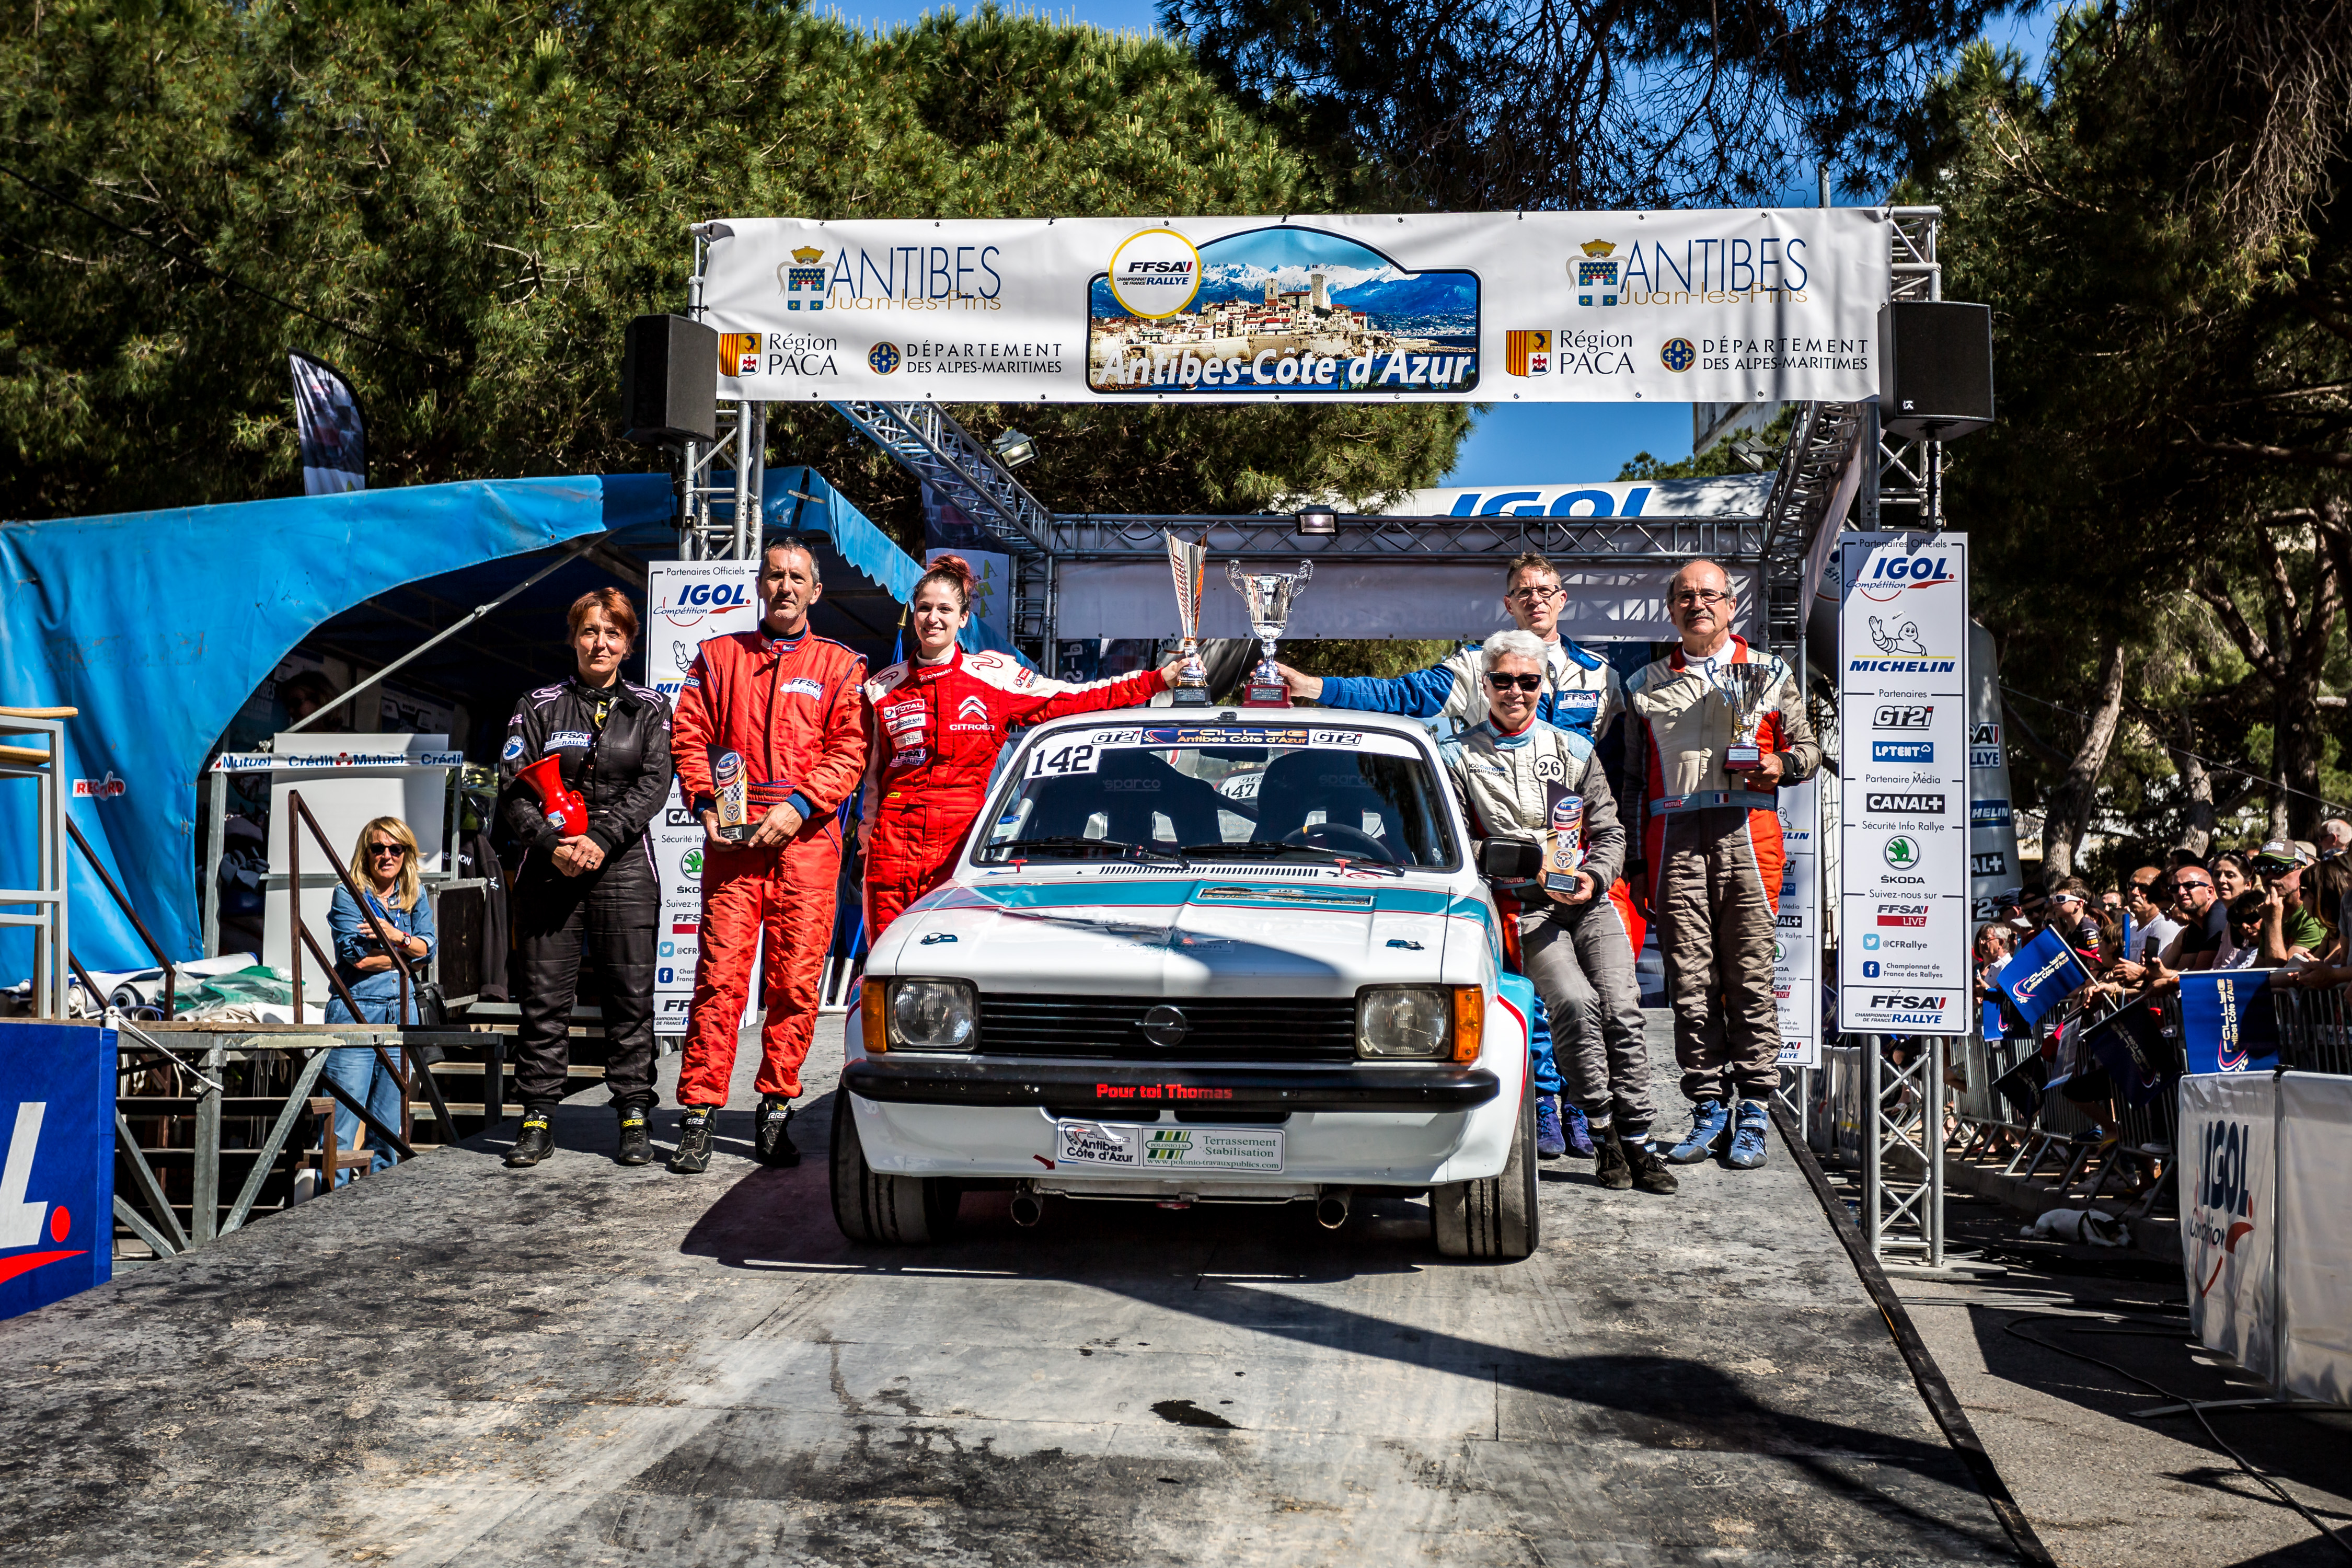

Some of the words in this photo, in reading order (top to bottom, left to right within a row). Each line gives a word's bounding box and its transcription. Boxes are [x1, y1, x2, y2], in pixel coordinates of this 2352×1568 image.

[1620, 238, 1808, 293] ANTIBES
[825, 246, 1001, 300] ANTIBES
[1146, 277, 1188, 285] RALLYE
[825, 289, 1001, 310] Juan-les-Pins
[1619, 281, 1808, 305] Juan-les-Pins
[769, 333, 837, 355] Région
[907, 338, 1062, 358] DÉPARTEMENT
[1560, 330, 1633, 354] Région
[1702, 335, 1868, 354] DÉPARTEMENT
[768, 354, 838, 376] PACA
[907, 361, 932, 374] DES
[936, 361, 1062, 374] ALPES-MARITIMES
[1098, 347, 1336, 385] Antibes-Côte
[1347, 348, 1471, 385] d'Azur
[1560, 352, 1635, 375] PACA
[1702, 358, 1728, 370] DES
[1735, 356, 1868, 370] ALPES-MARITIMES
[1860, 539, 1908, 549] Partenaires
[1911, 539, 1947, 548] Officiels
[666, 568, 710, 576] Partenaires
[712, 566, 745, 575] Officiels
[1846, 579, 1906, 591] Compétition
[653, 606, 707, 617] Compétition
[1849, 661, 1955, 672] MICHELIN
[1879, 689, 1928, 699] Partenaires
[896, 702, 923, 713] TOTAL
[1873, 706, 1934, 727] GT2i
[890, 717, 922, 730] BFGoodrich
[1091, 731, 1141, 744] GT2i
[1312, 731, 1363, 745] GT2i
[223, 755, 271, 768] Mutuel
[288, 755, 333, 767] Crédit
[353, 754, 404, 766] Mutuel
[1032, 744, 1094, 776] 142
[1469, 768, 1505, 777] assurances
[1539, 761, 1560, 777] 26
[1104, 779, 1161, 791] sparco
[1866, 775, 1910, 784] Partenaire
[1912, 775, 1941, 784] Média
[1223, 784, 1255, 799] 147
[1869, 795, 1943, 811] CANAL+
[1862, 821, 1896, 830] Sécurité
[1898, 821, 1914, 831] Info
[1916, 823, 1944, 833] Rallye
[662, 835, 693, 843] Sécurité
[1881, 874, 1926, 884] ŠKODA
[1869, 890, 1926, 899] Suivez-nous
[1903, 917, 1926, 926] LIVE
[1883, 940, 1928, 950] @CFRallye
[2042, 967, 2055, 979] Côte
[2226, 978, 2235, 1002] d'Azur
[1892, 1014, 1942, 1024] RALLYE
[1097, 1083, 1136, 1098] Pour
[1140, 1083, 1161, 1098] toi
[1166, 1084, 1232, 1099] Thomas
[1081, 1139, 1123, 1152] Antibes
[1203, 1135, 1276, 1147] Terrassement
[1067, 1146, 1095, 1158] Côte
[1099, 1151, 1133, 1163] d'Azur
[1205, 1147, 1274, 1158] Stabilisation
[1147, 1159, 1279, 1169] www.polonio-travauxpublics.com
